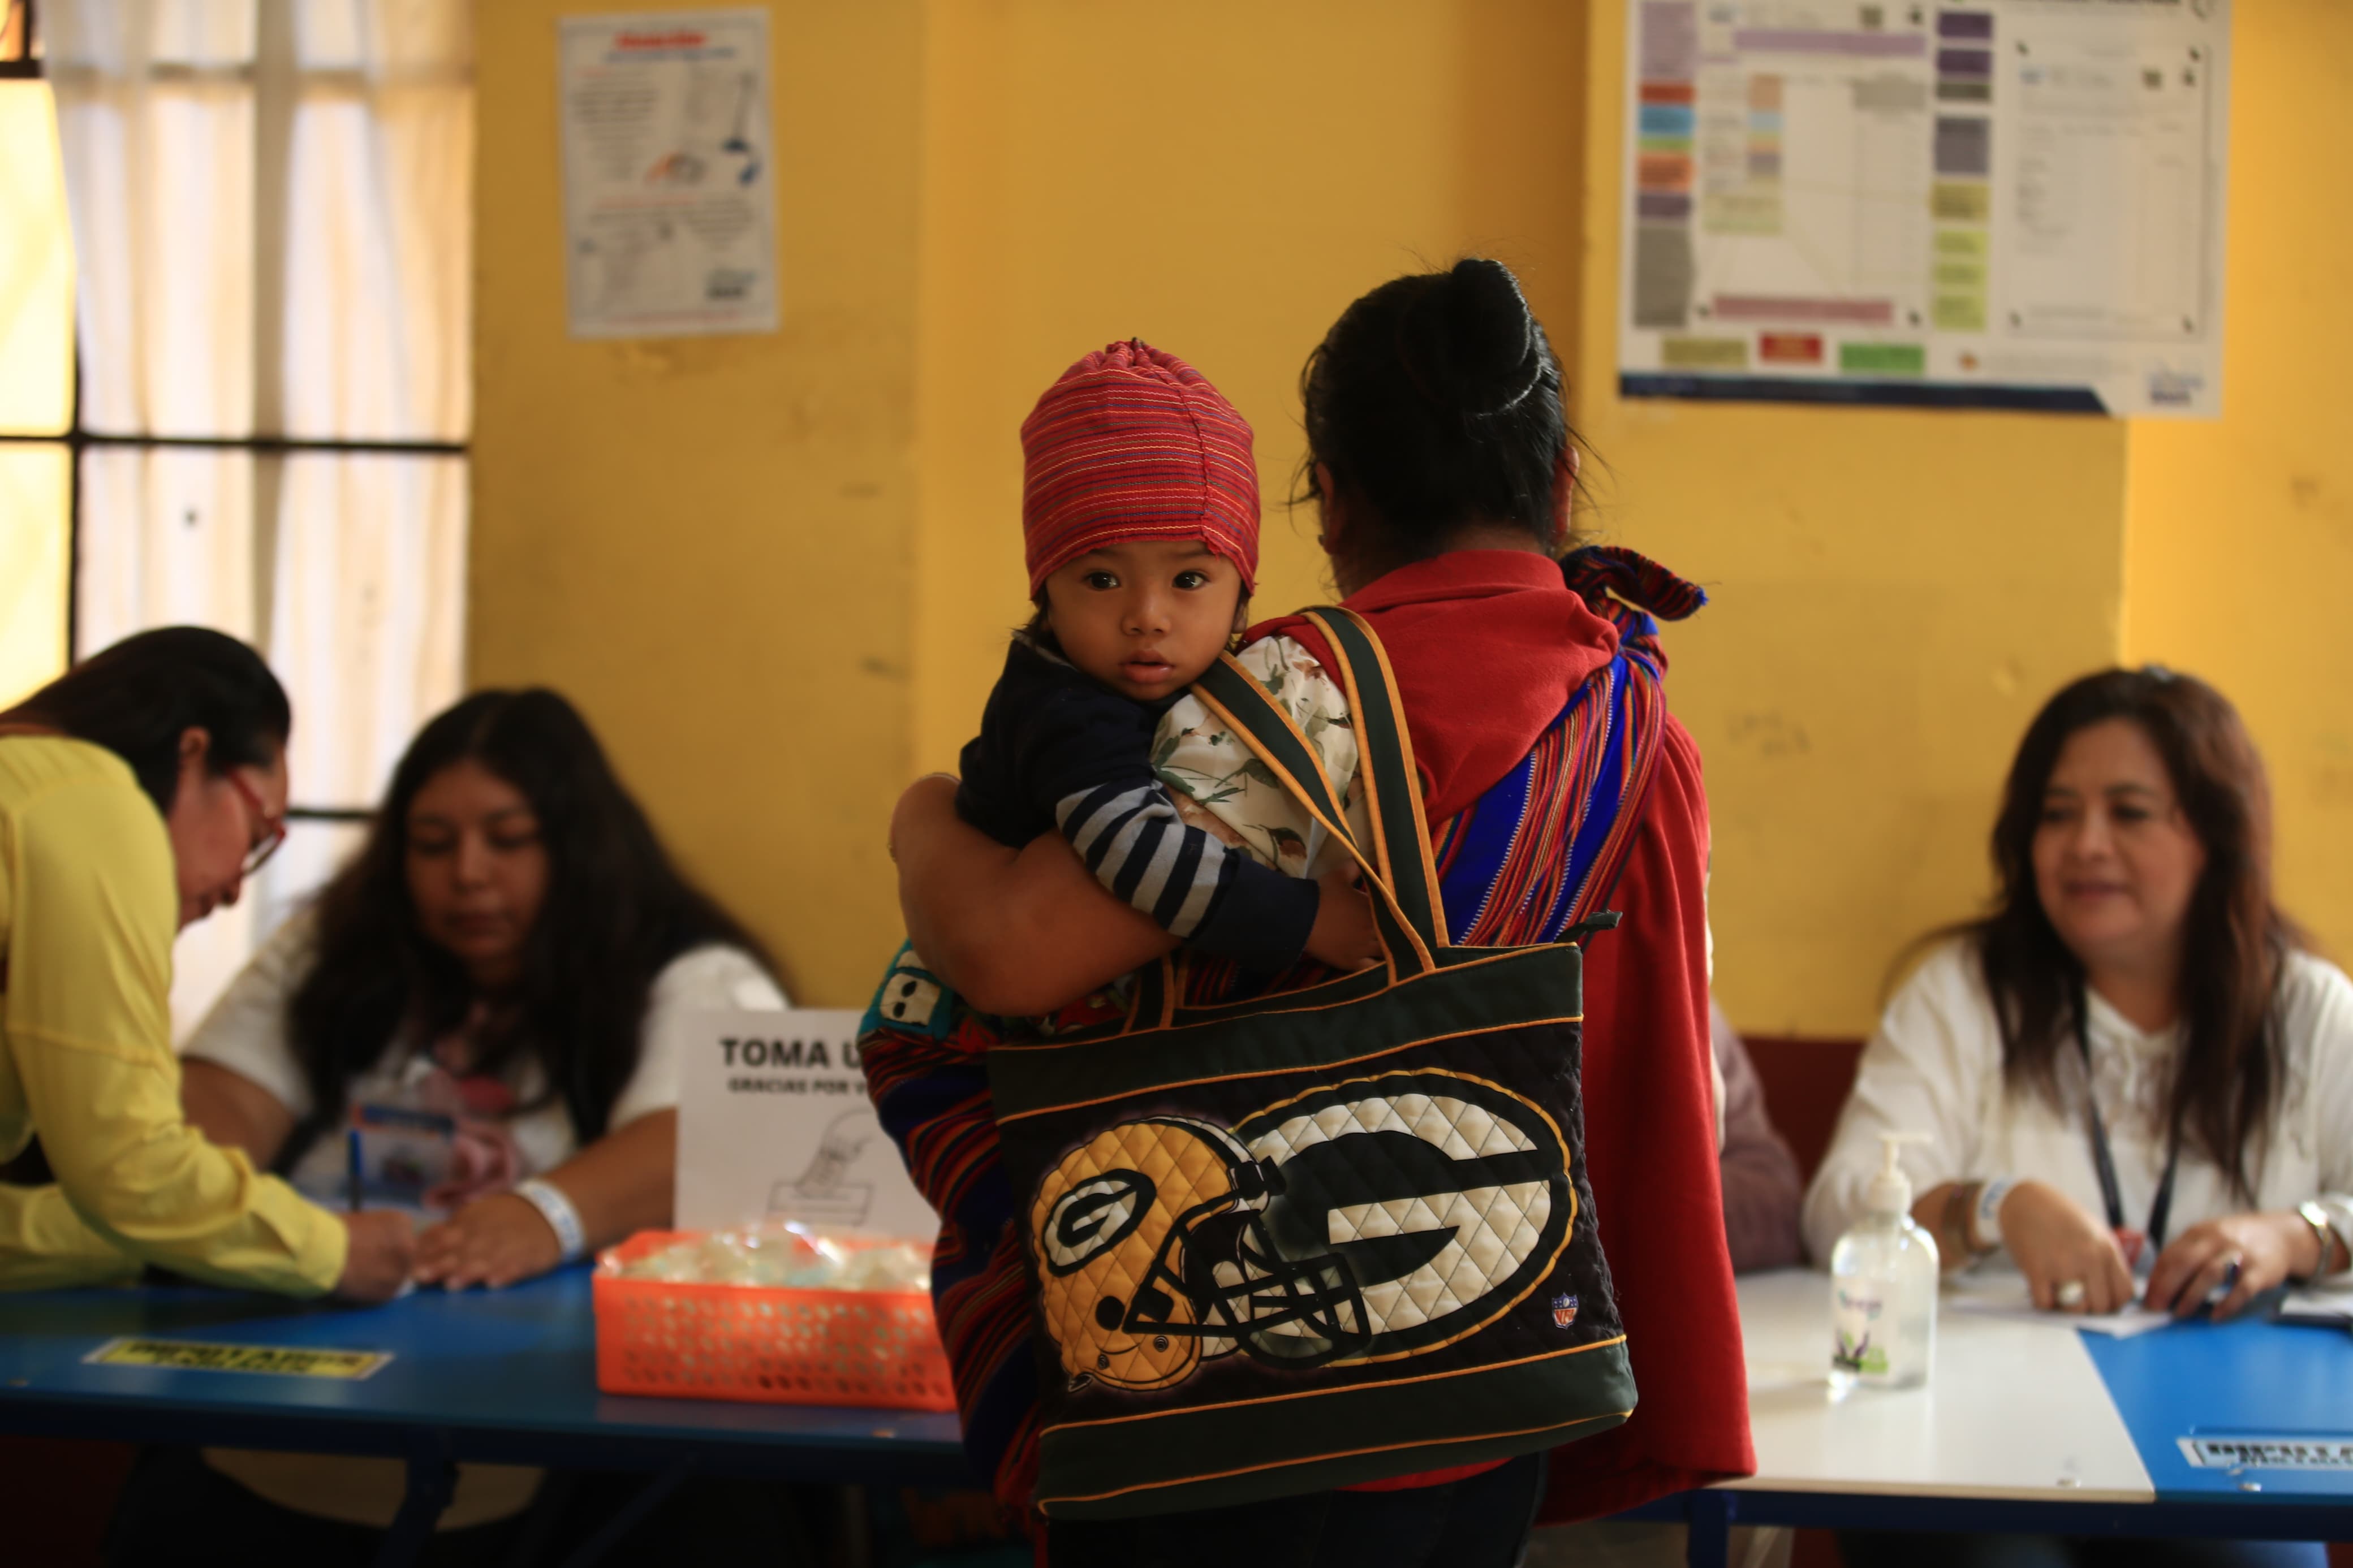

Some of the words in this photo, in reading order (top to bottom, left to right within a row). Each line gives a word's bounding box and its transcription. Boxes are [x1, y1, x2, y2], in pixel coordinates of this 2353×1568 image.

[720, 1038, 829, 1068] TOMA
[729, 1077, 807, 1095] GRACIAS
[813, 1079, 848, 1096] POR
[1044, 1180, 1137, 1267] G
[1199, 1092, 1553, 1357] G
